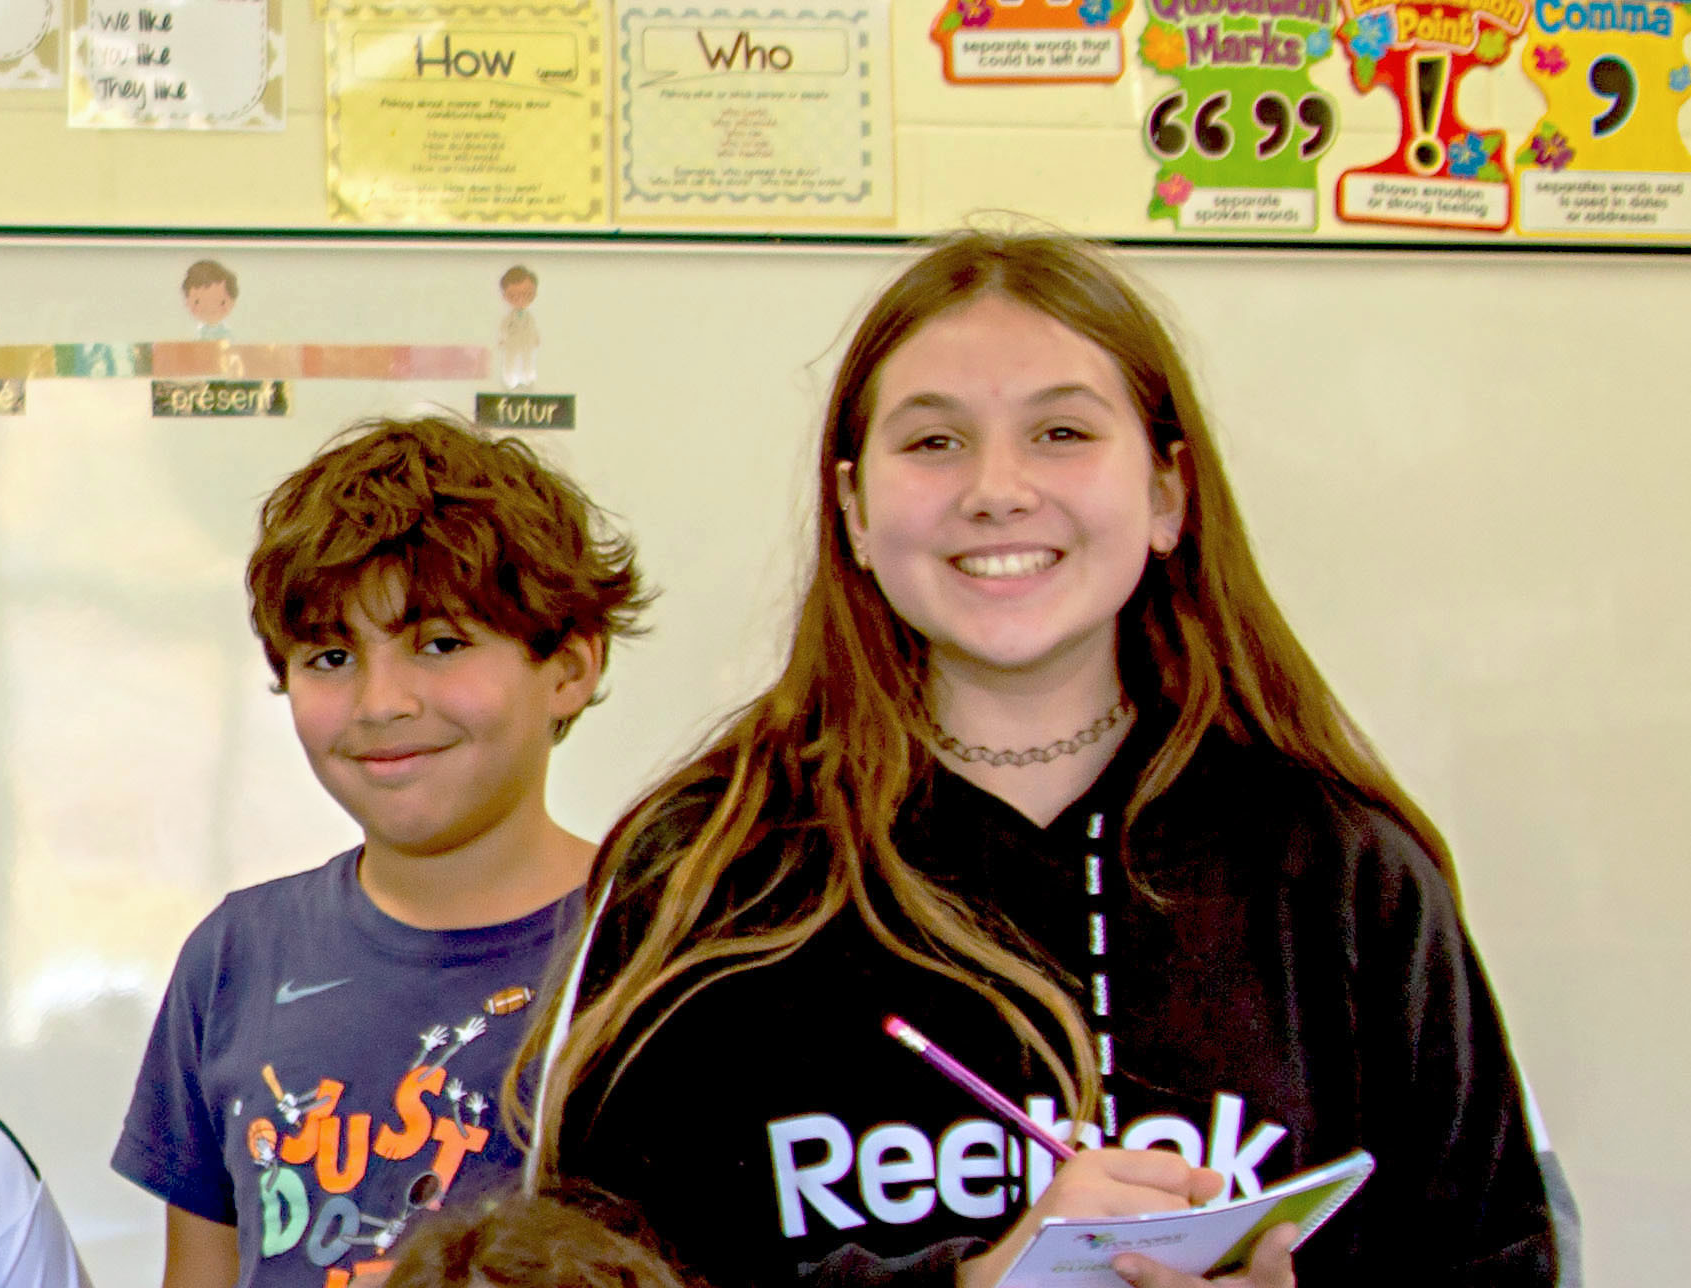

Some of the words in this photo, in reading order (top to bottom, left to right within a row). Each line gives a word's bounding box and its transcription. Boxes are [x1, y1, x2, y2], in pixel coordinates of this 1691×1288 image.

[98, 10, 130, 32] We
[138, 9, 172, 32] like
[1397, 7, 1473, 45] Point
[1535, 0, 1673, 37] Comma
[137, 43, 171, 66] like
[416, 34, 516, 78] How
[696, 30, 794, 71] Who
[1186, 22, 1304, 67] Marks
[97, 78, 147, 111] They
[154, 79, 187, 100] like
[497, 397, 558, 425] futur
[279, 1064, 490, 1212] JUST
[260, 1166, 361, 1268] DO
